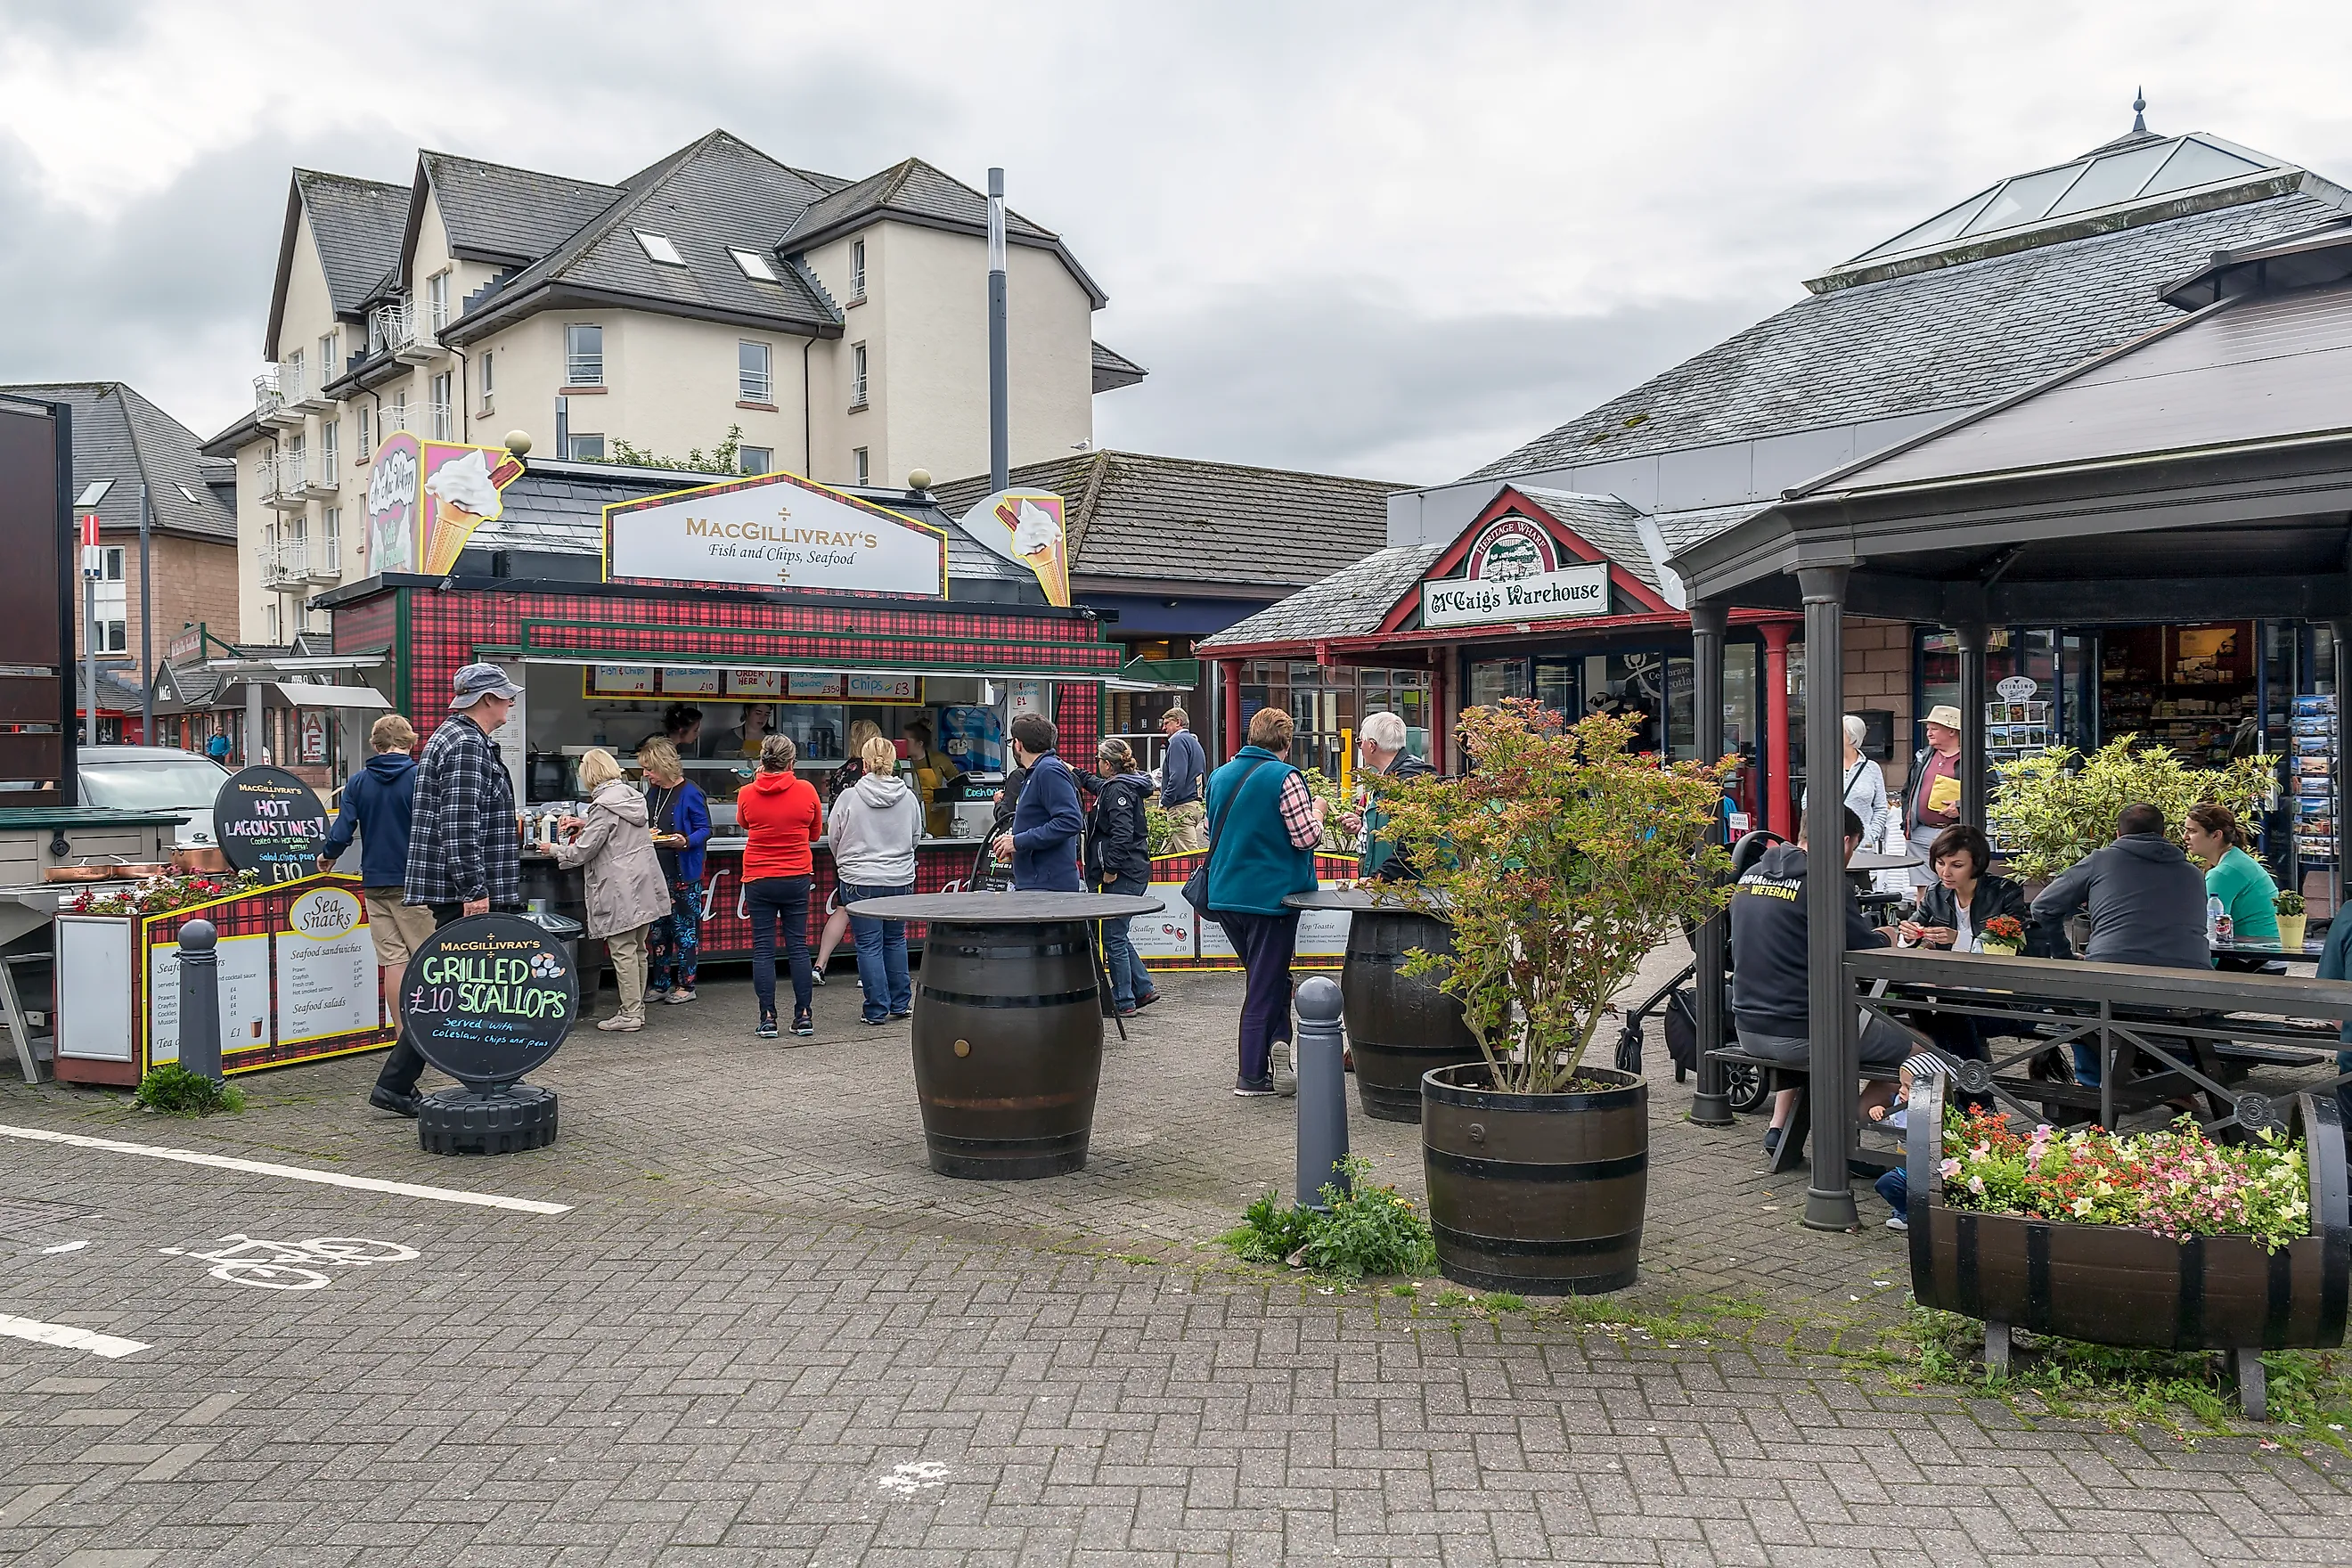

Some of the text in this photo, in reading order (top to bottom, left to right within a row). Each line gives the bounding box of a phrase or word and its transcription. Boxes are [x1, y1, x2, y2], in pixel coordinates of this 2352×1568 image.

[1476, 521, 1547, 556] HERITAGE WHARF
[708, 543, 855, 568] Fish and Chips, Seafood
[1431, 582, 1599, 614] McCaig's Warehouse
[625, 667, 645, 676] Chips
[699, 682, 714, 691] £10
[738, 677, 758, 685] HERE
[851, 676, 882, 695] Chips
[894, 682, 910, 695] £3
[1017, 697, 1027, 706] £1
[254, 799, 291, 817] HOT
[225, 817, 326, 841] LAGOUSTINES!
[312, 895, 339, 916] Sea
[300, 907, 352, 930] Snacks
[1301, 923, 1312, 931] Top
[1133, 926, 1156, 934] Scallop
[290, 943, 362, 961] Seafood sandwiches
[422, 956, 529, 984] GRILLED
[292, 997, 346, 1015] Seafood salads
[409, 984, 568, 1019] £10 SCALLOPS
[489, 1022, 513, 1032] with
[157, 1037, 173, 1049] Tea
[231, 1027, 241, 1038] £1
[527, 1041, 549, 1049] peas
